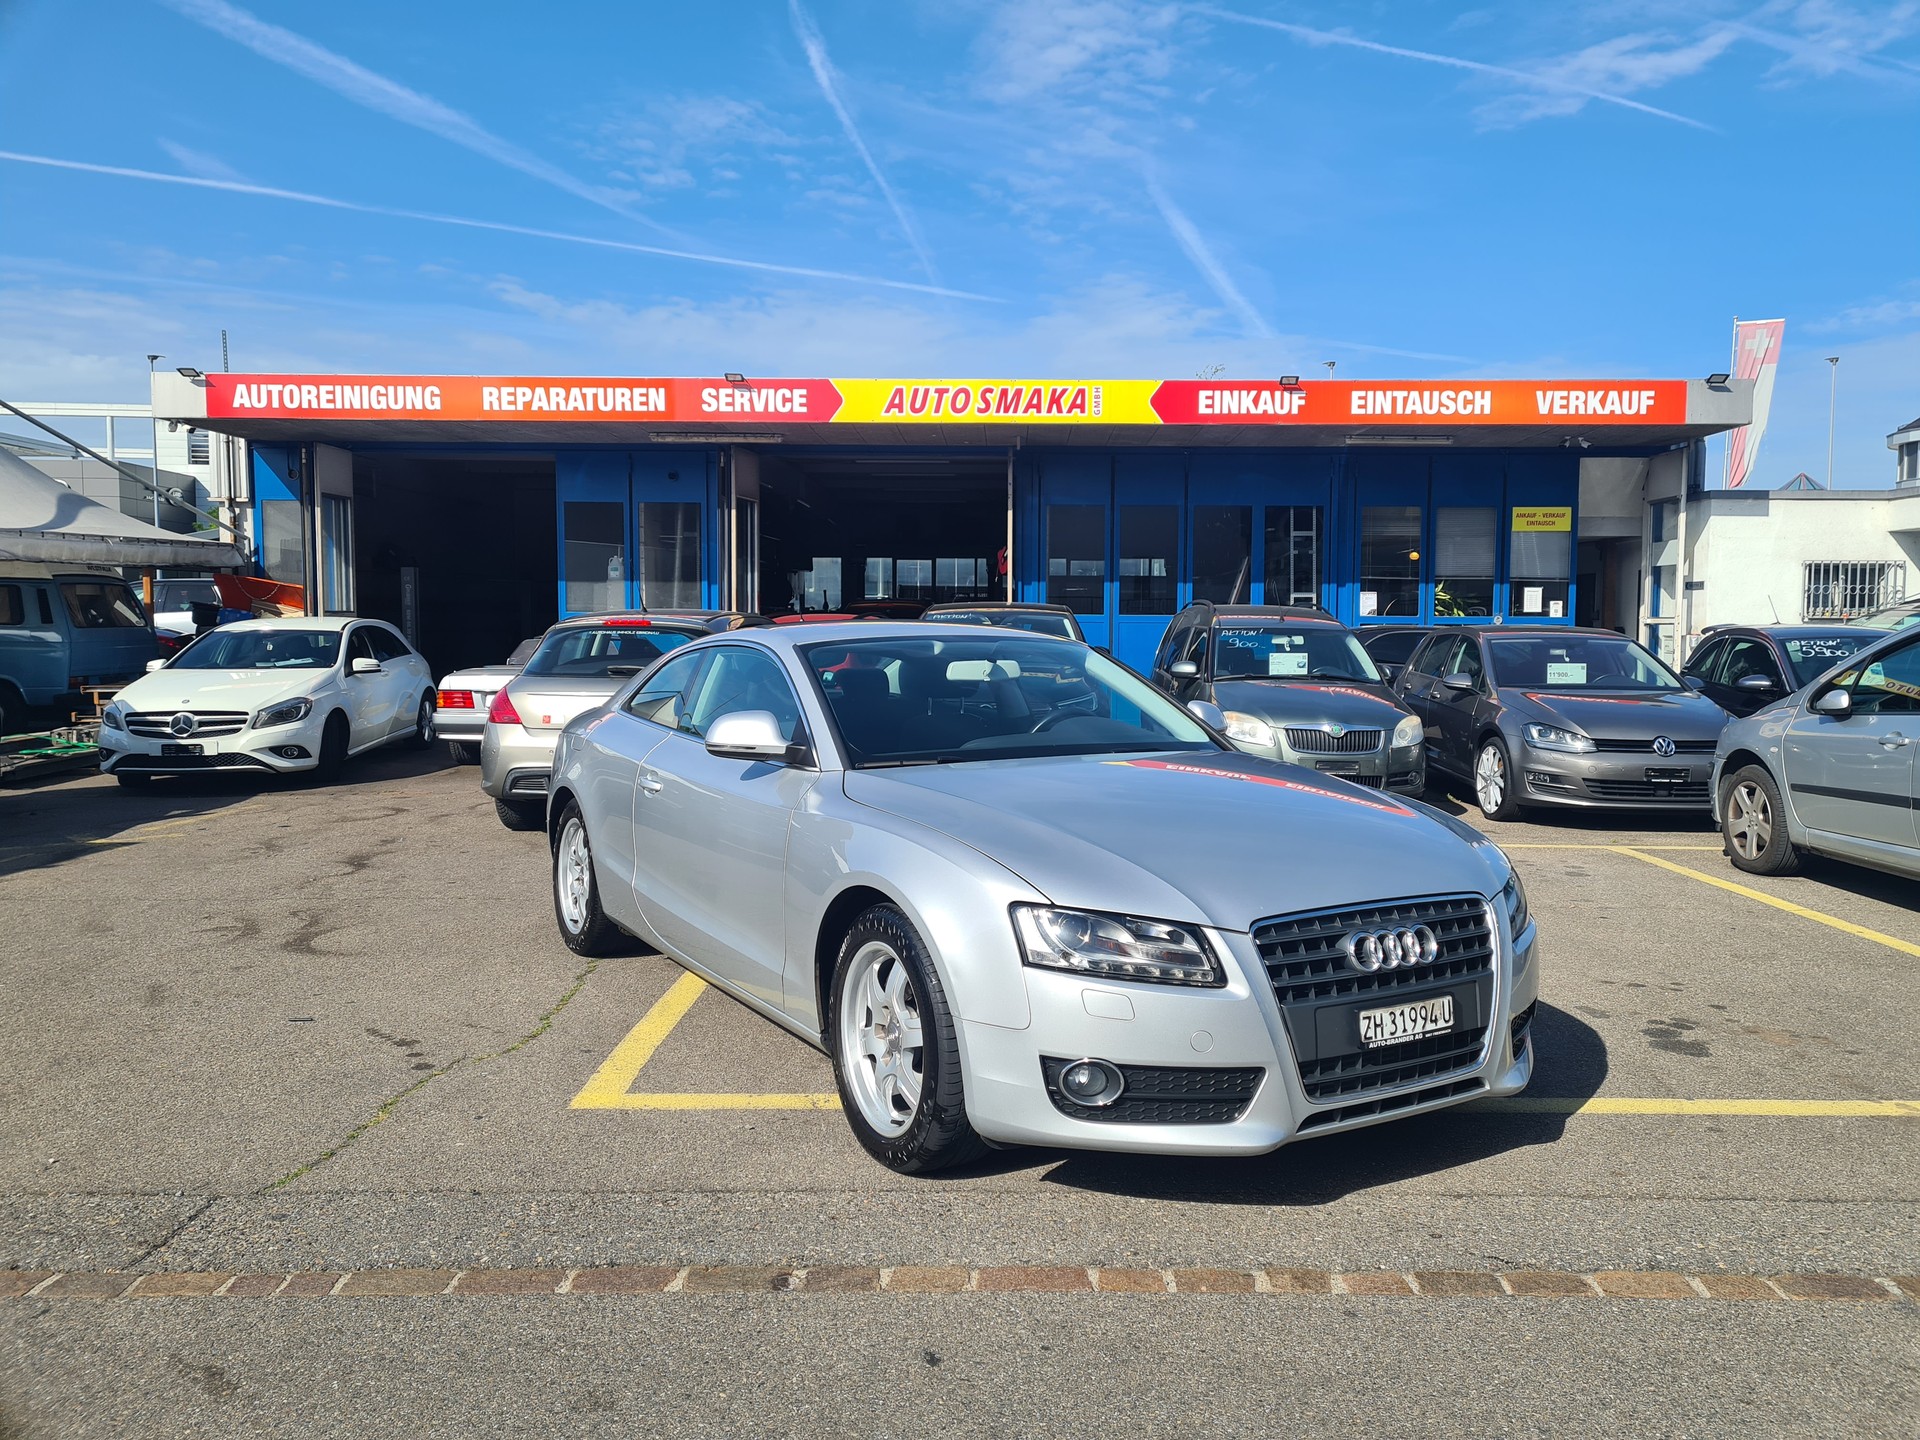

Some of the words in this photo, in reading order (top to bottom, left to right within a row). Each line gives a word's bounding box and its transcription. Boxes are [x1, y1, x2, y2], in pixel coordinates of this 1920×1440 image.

[232, 383, 441, 410] AUTOREINIGUNG
[482, 386, 666, 412] REPARATUREN
[701, 387, 808, 413] SERVICE
[883, 387, 972, 414] AUTO
[976, 387, 1087, 414] SMAKA
[1093, 386, 1101, 416] GMBH
[1198, 389, 1306, 415] EINKAUF
[1350, 390, 1492, 415] EINTAUSCH
[1535, 390, 1655, 415] VERKAUF
[1362, 1013, 1384, 1041] ZH
